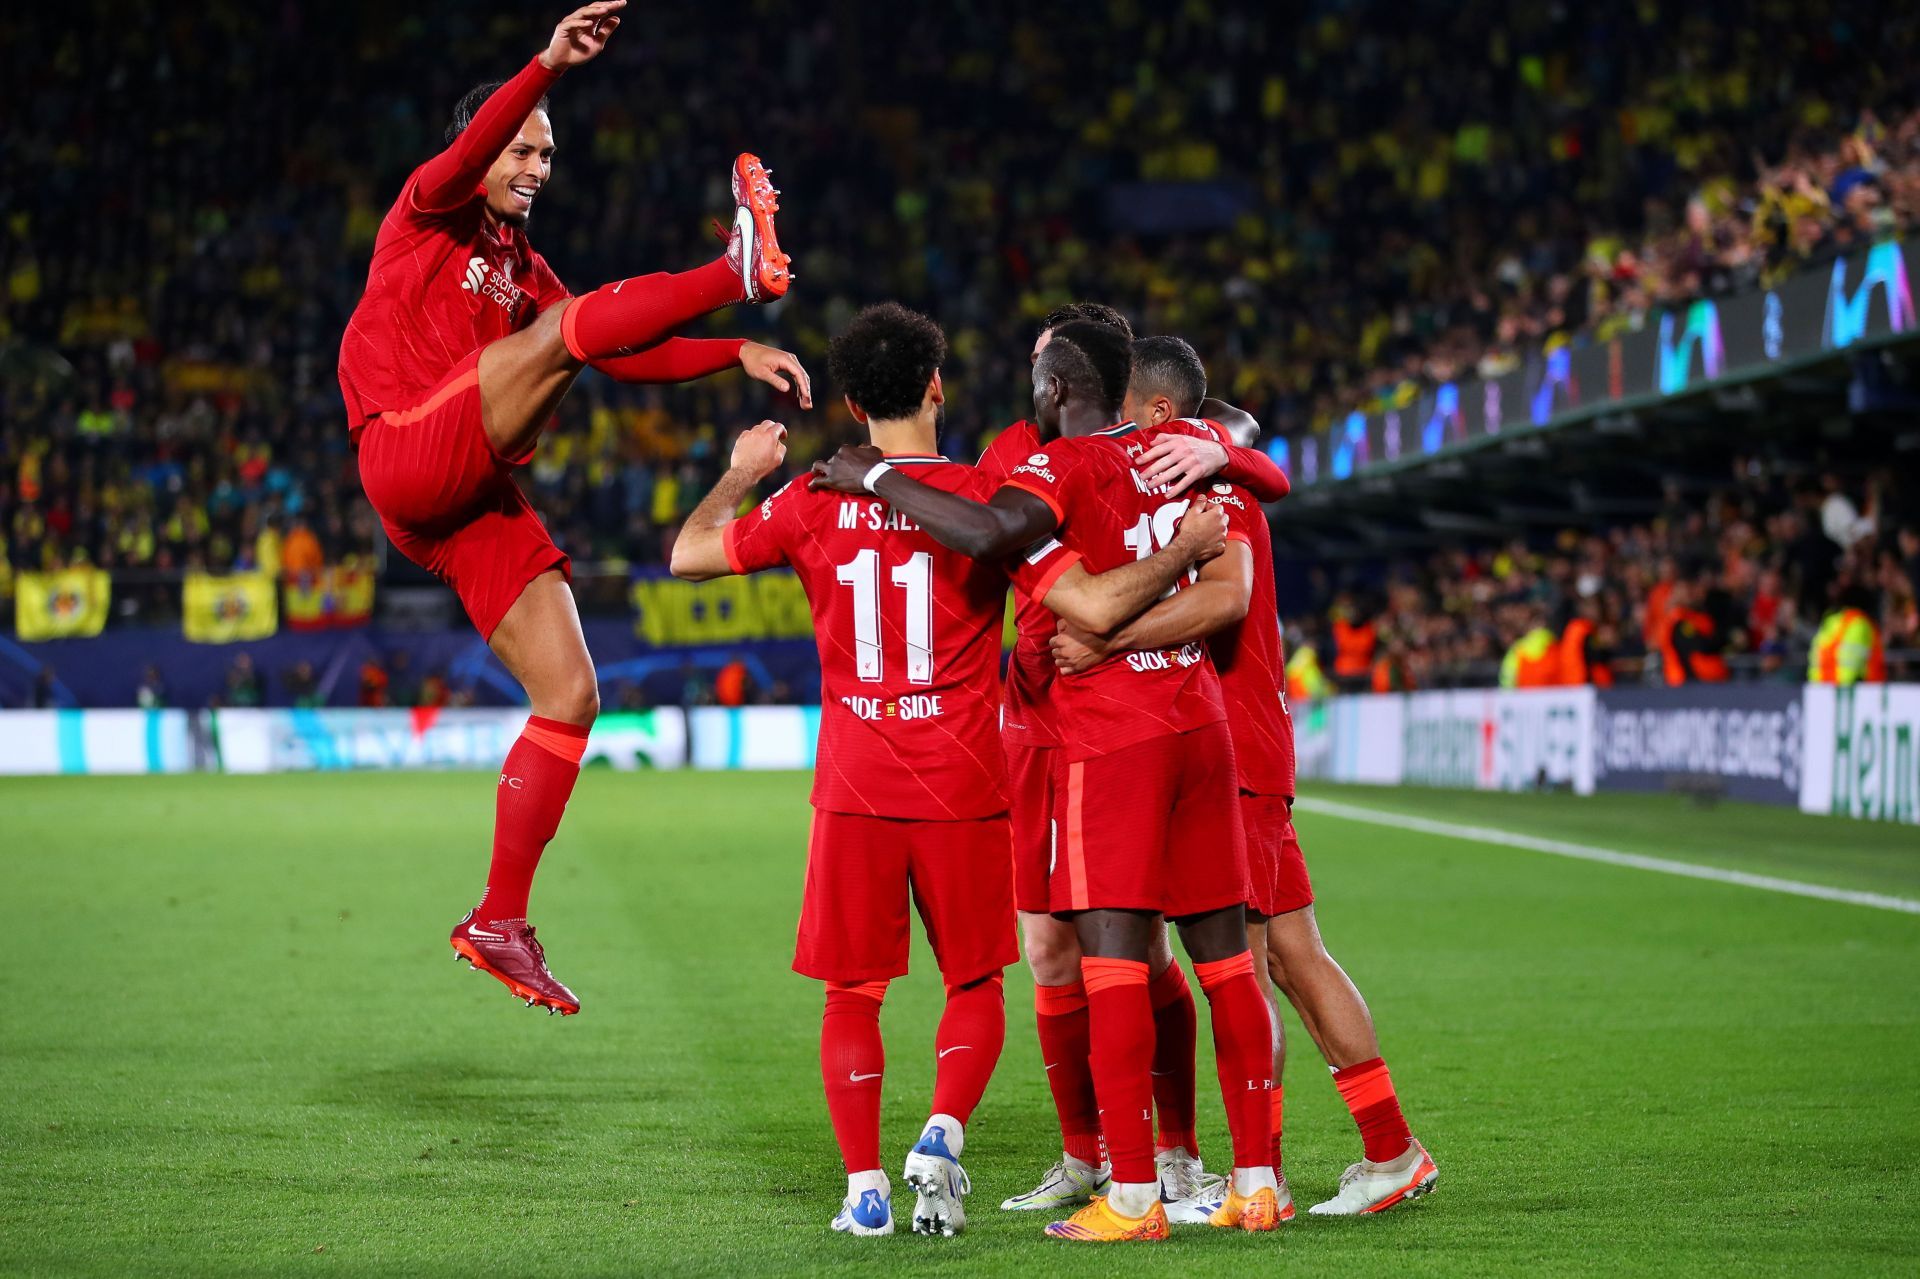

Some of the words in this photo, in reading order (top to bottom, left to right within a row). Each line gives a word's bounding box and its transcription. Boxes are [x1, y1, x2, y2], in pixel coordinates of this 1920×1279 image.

[836, 548, 934, 686] 11
[898, 695, 945, 720] SIDE
[1833, 687, 1920, 822] Hein
